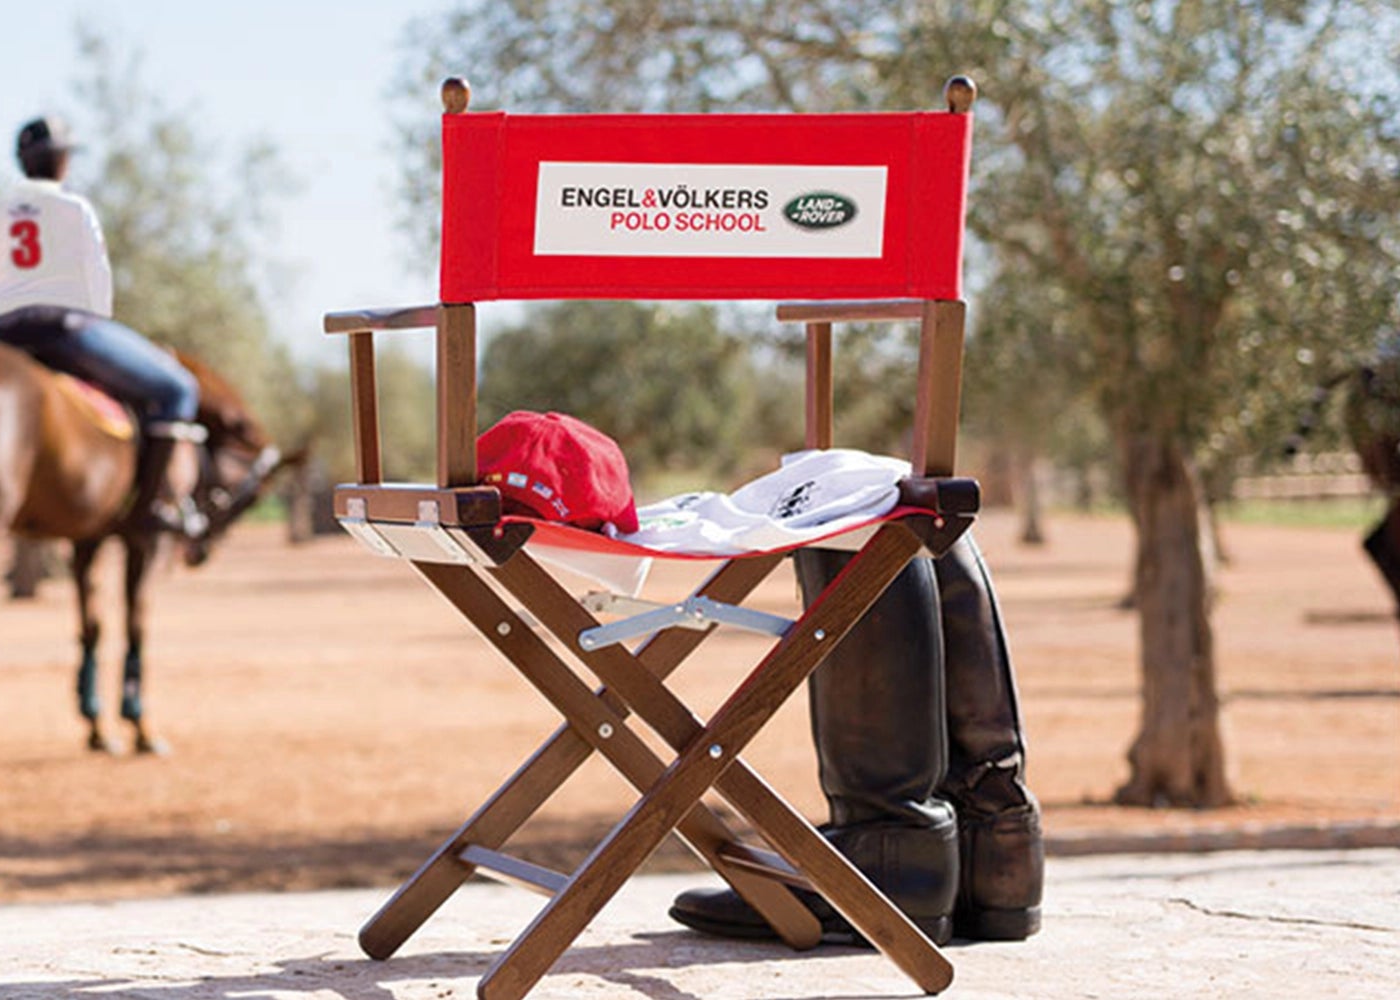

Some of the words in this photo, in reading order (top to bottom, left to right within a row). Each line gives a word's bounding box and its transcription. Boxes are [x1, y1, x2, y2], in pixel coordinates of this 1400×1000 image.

[561, 185, 769, 209] ENGEL&VÖLKERS
[610, 212, 671, 231] POLO
[674, 213, 766, 232] SCHOOL
[10, 219, 42, 271] 3
